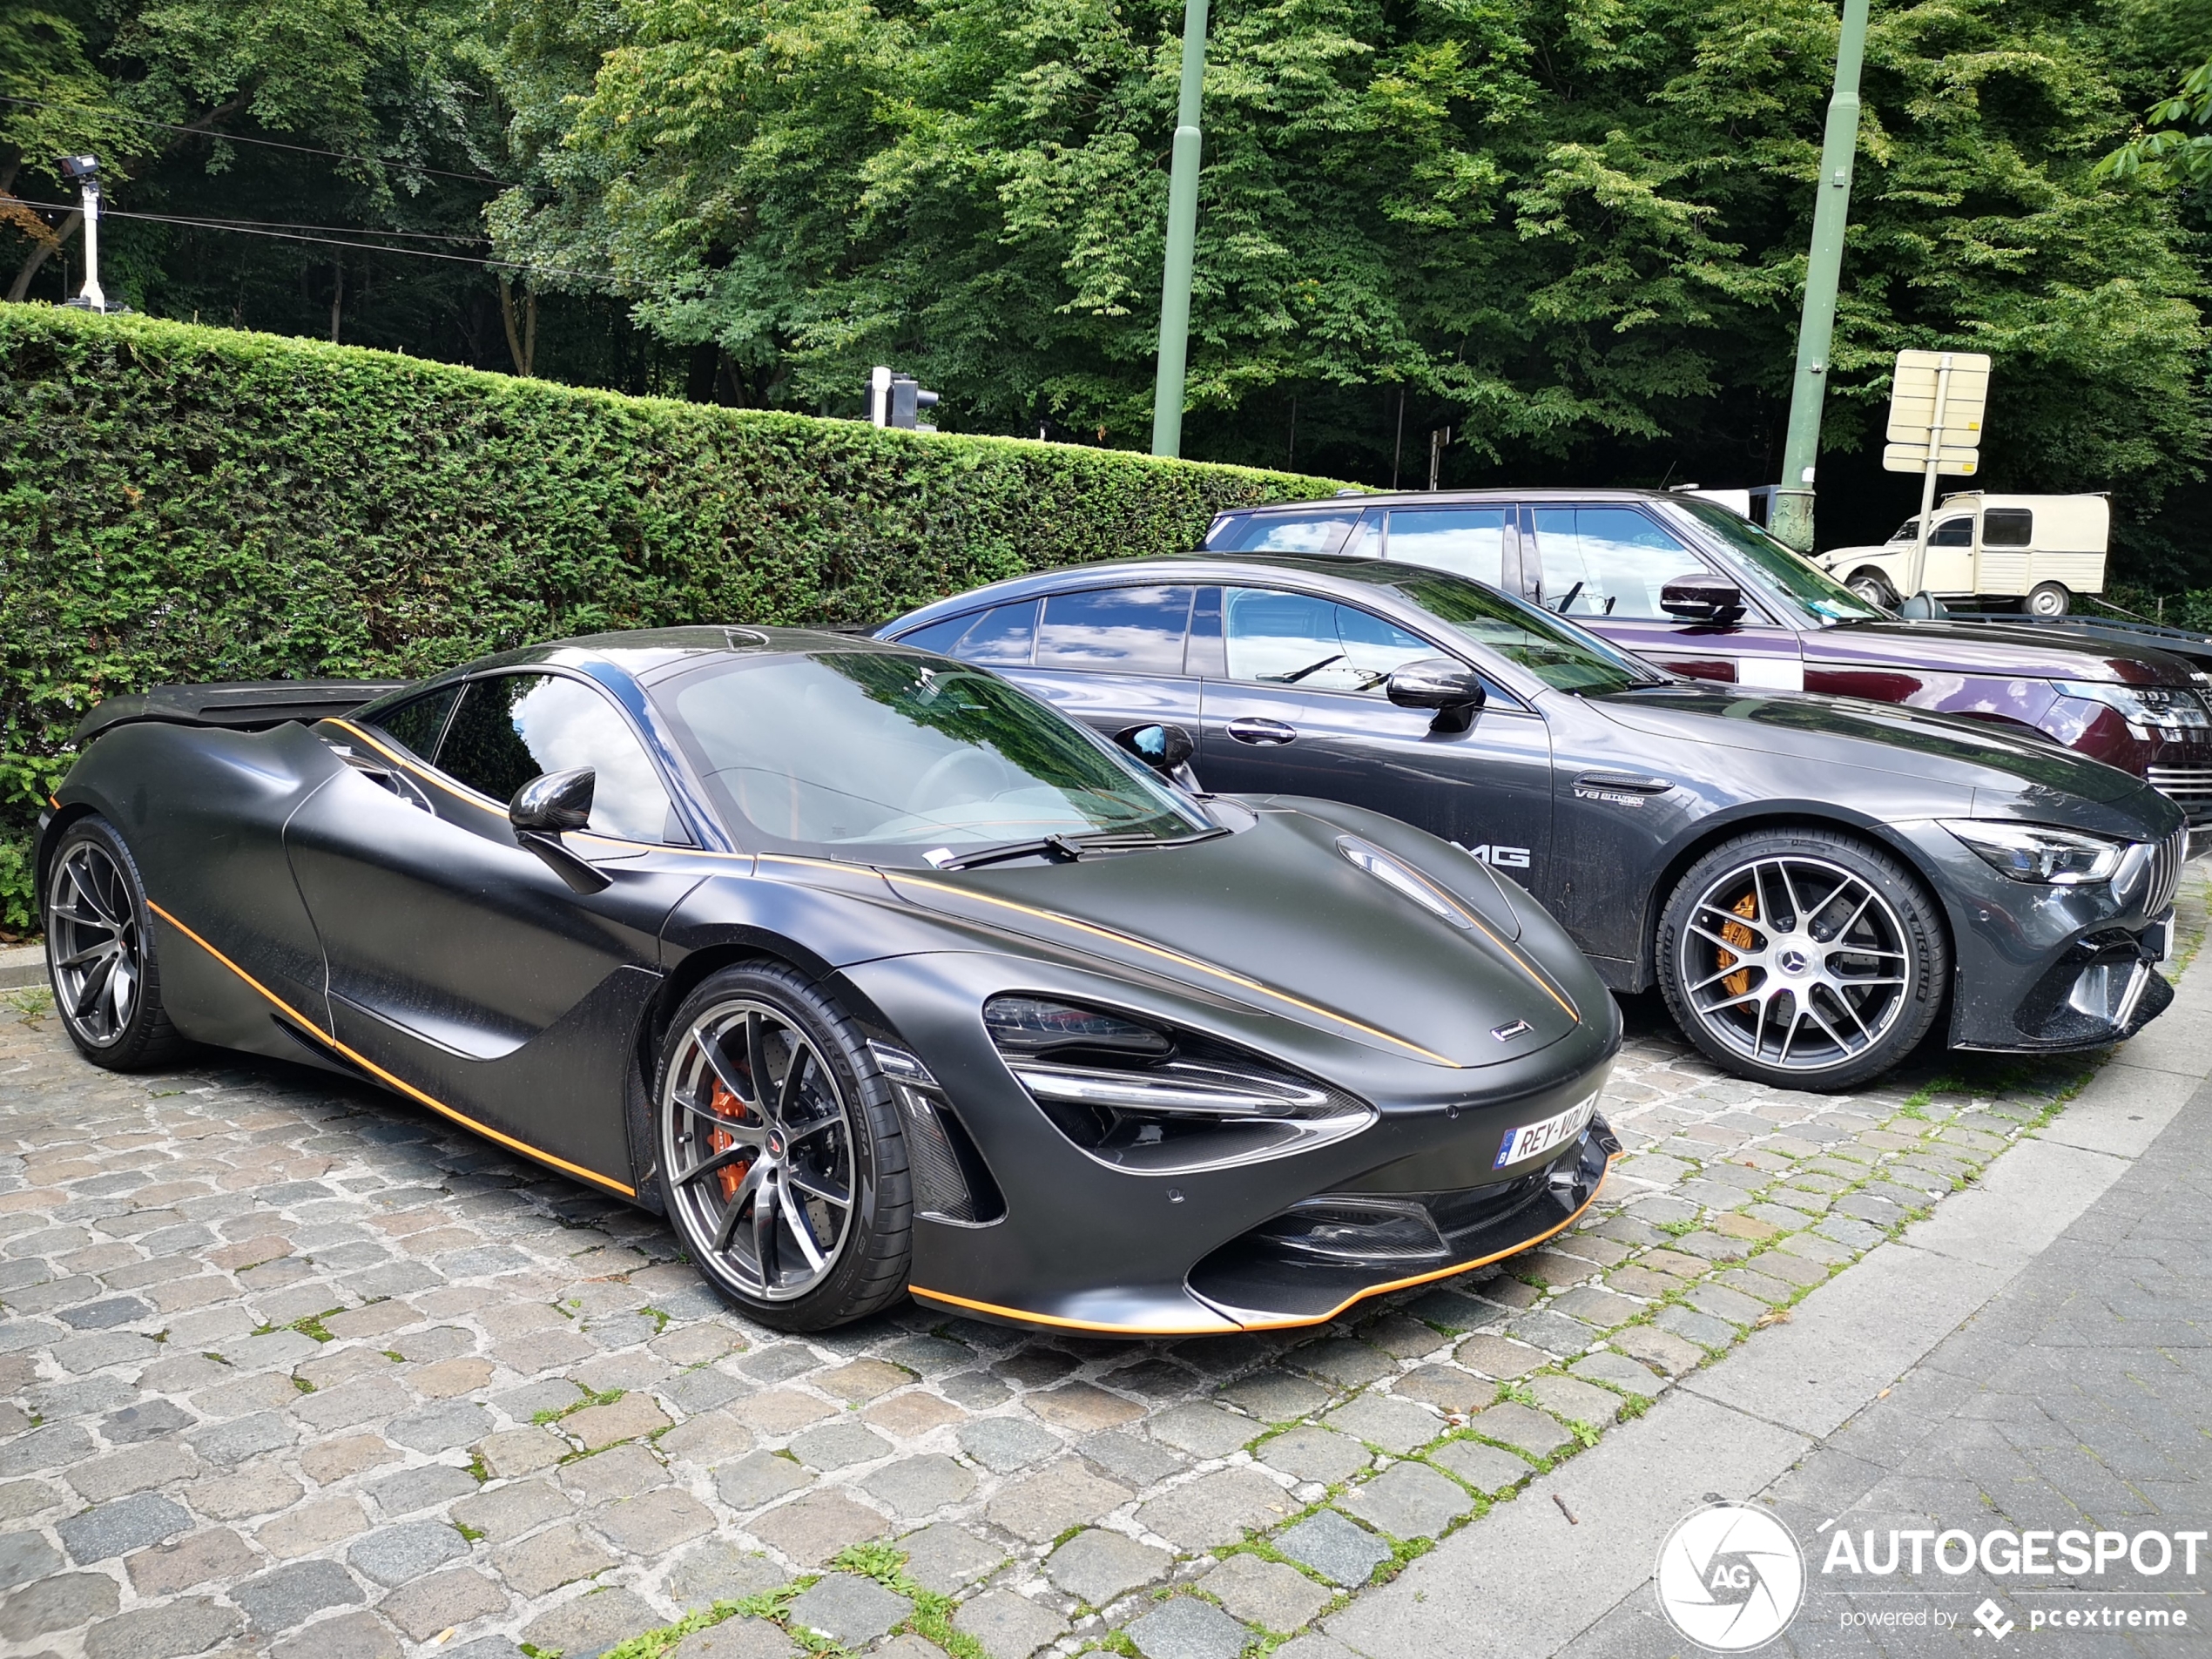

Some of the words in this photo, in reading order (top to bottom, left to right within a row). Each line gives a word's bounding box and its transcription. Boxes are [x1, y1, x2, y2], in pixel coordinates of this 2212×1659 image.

[1574, 789, 1599, 799] V8
[1451, 841, 1531, 868] MG
[1911, 921, 1930, 1000] MICHELIN
[850, 1092, 869, 1157] CORSA
[1497, 1152, 1507, 1165] B
[1518, 1099, 1593, 1157] REY-VOLT
